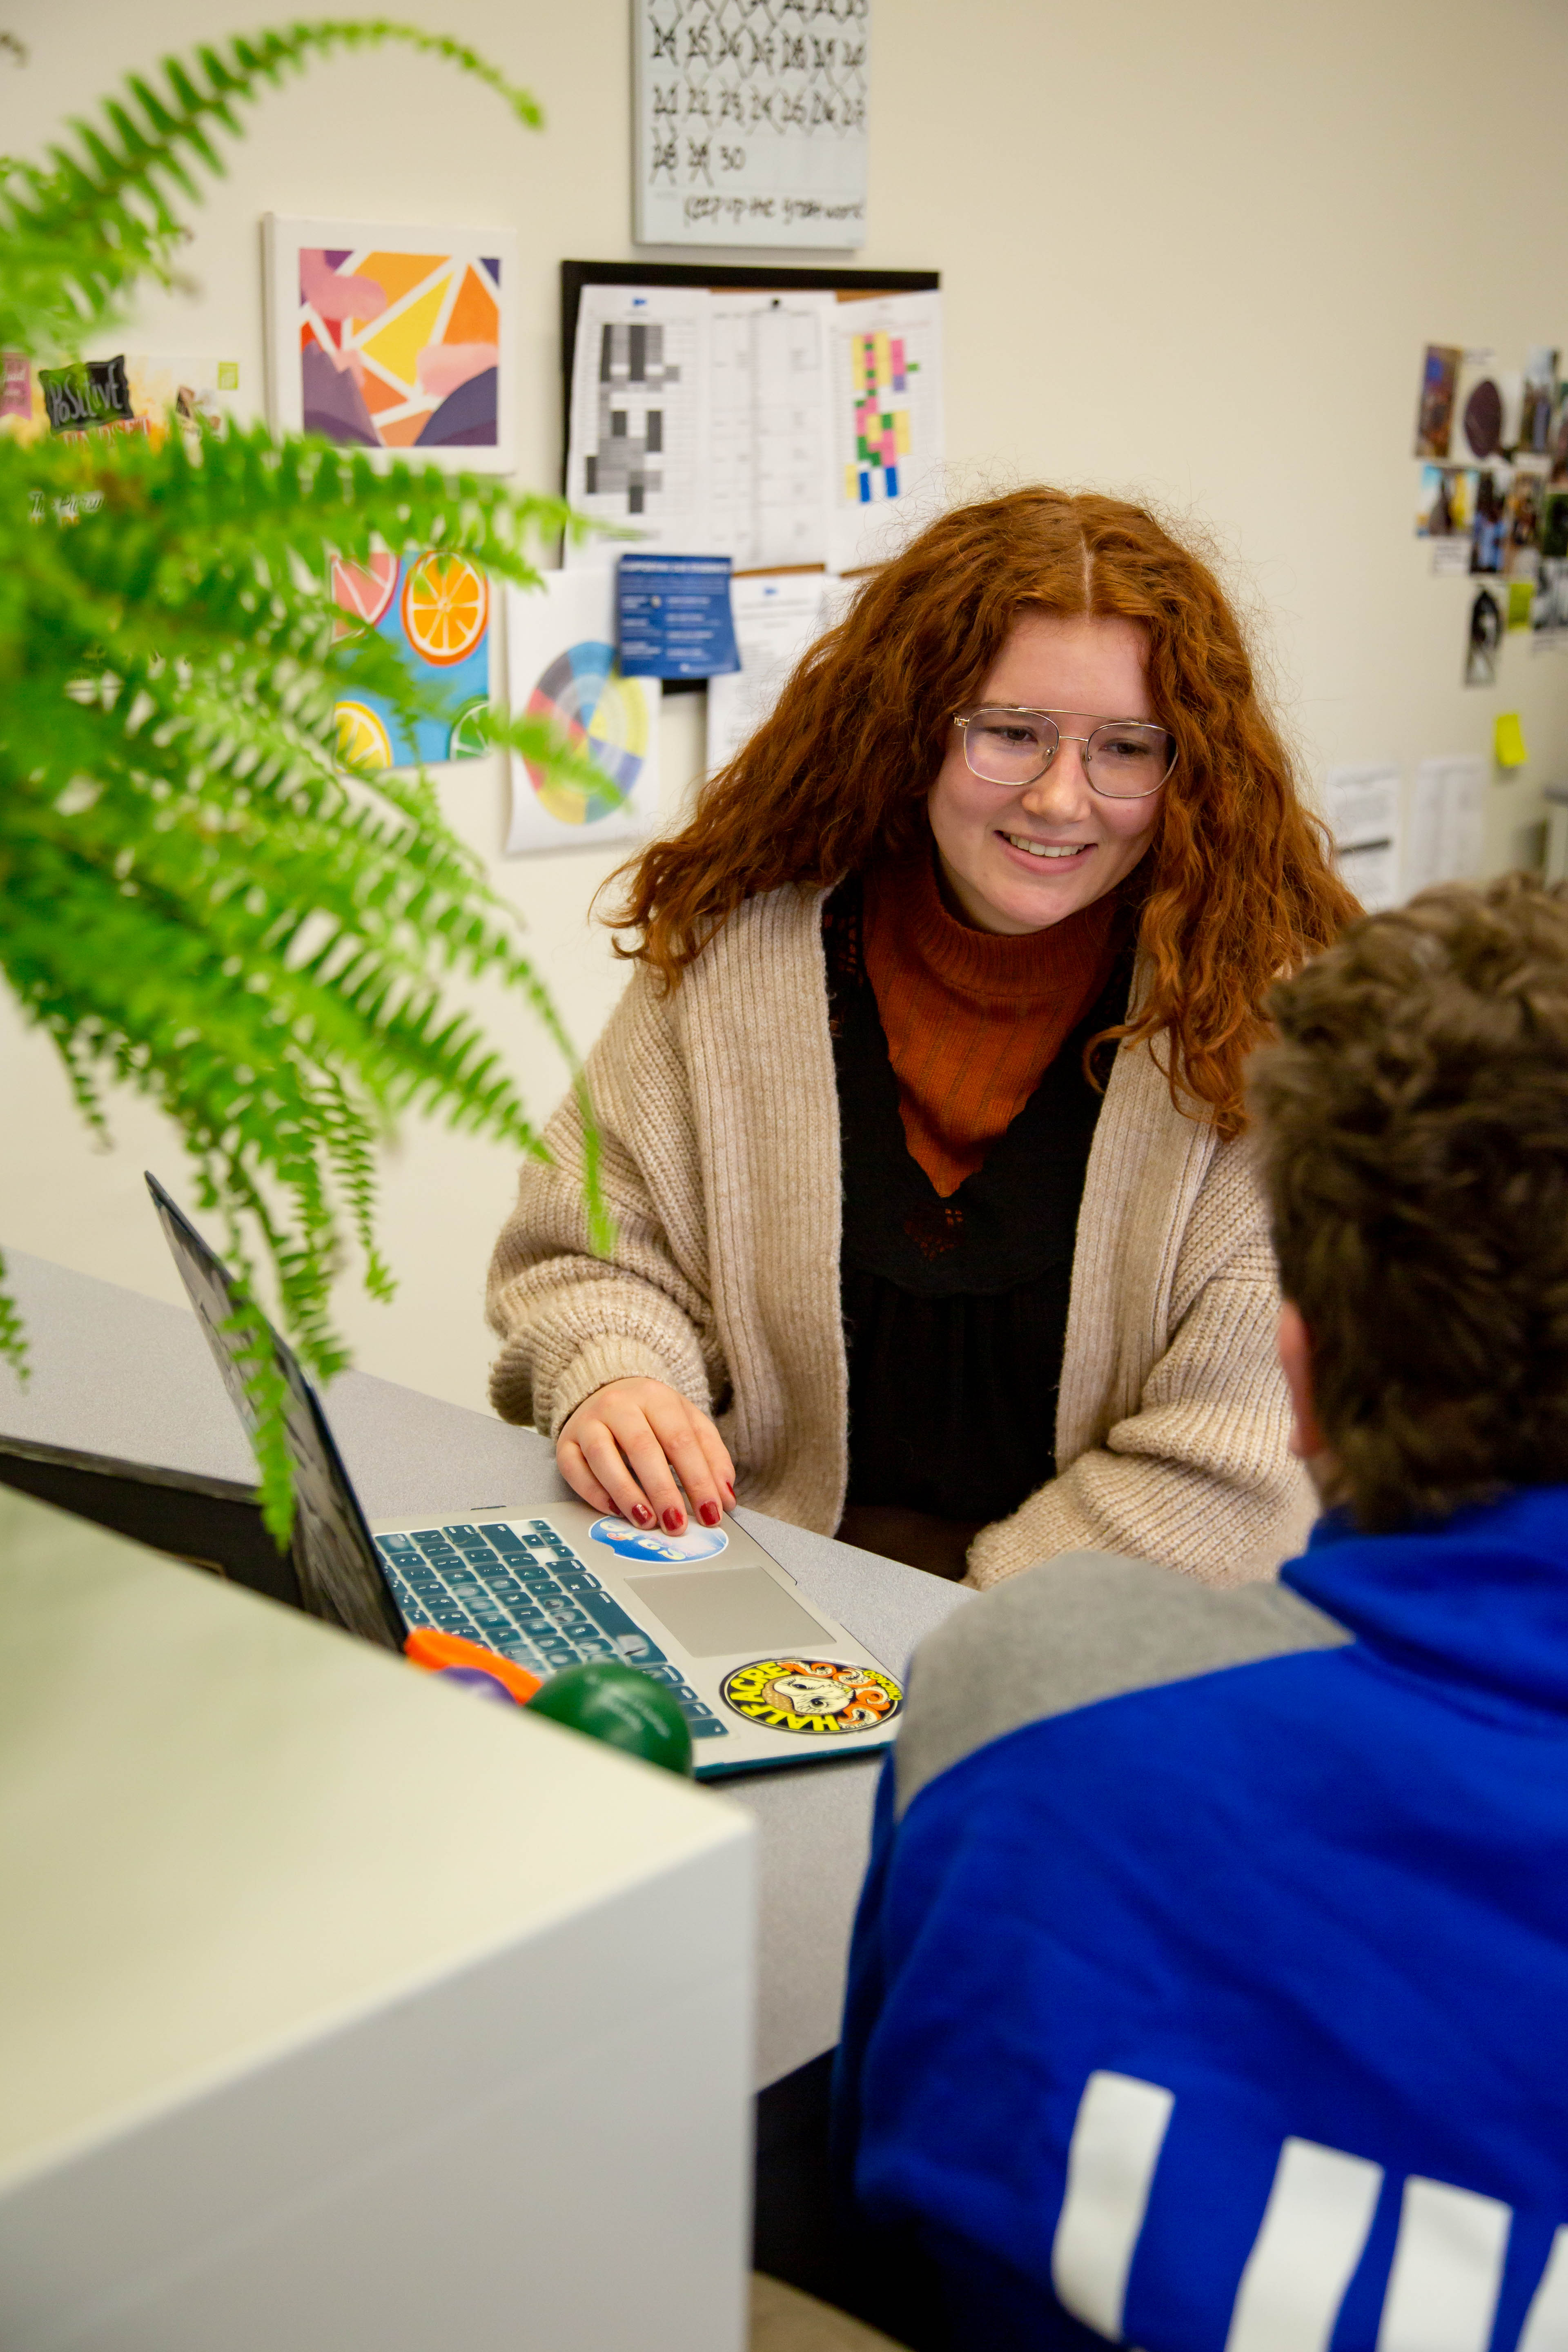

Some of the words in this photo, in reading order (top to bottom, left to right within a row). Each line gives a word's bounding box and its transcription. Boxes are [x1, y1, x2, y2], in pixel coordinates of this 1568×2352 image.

[719, 145, 746, 172] 30
[730, 1662, 791, 1703] ACRE
[863, 1670, 903, 1701] CHICAGO
[740, 1703, 840, 1731] HALF
